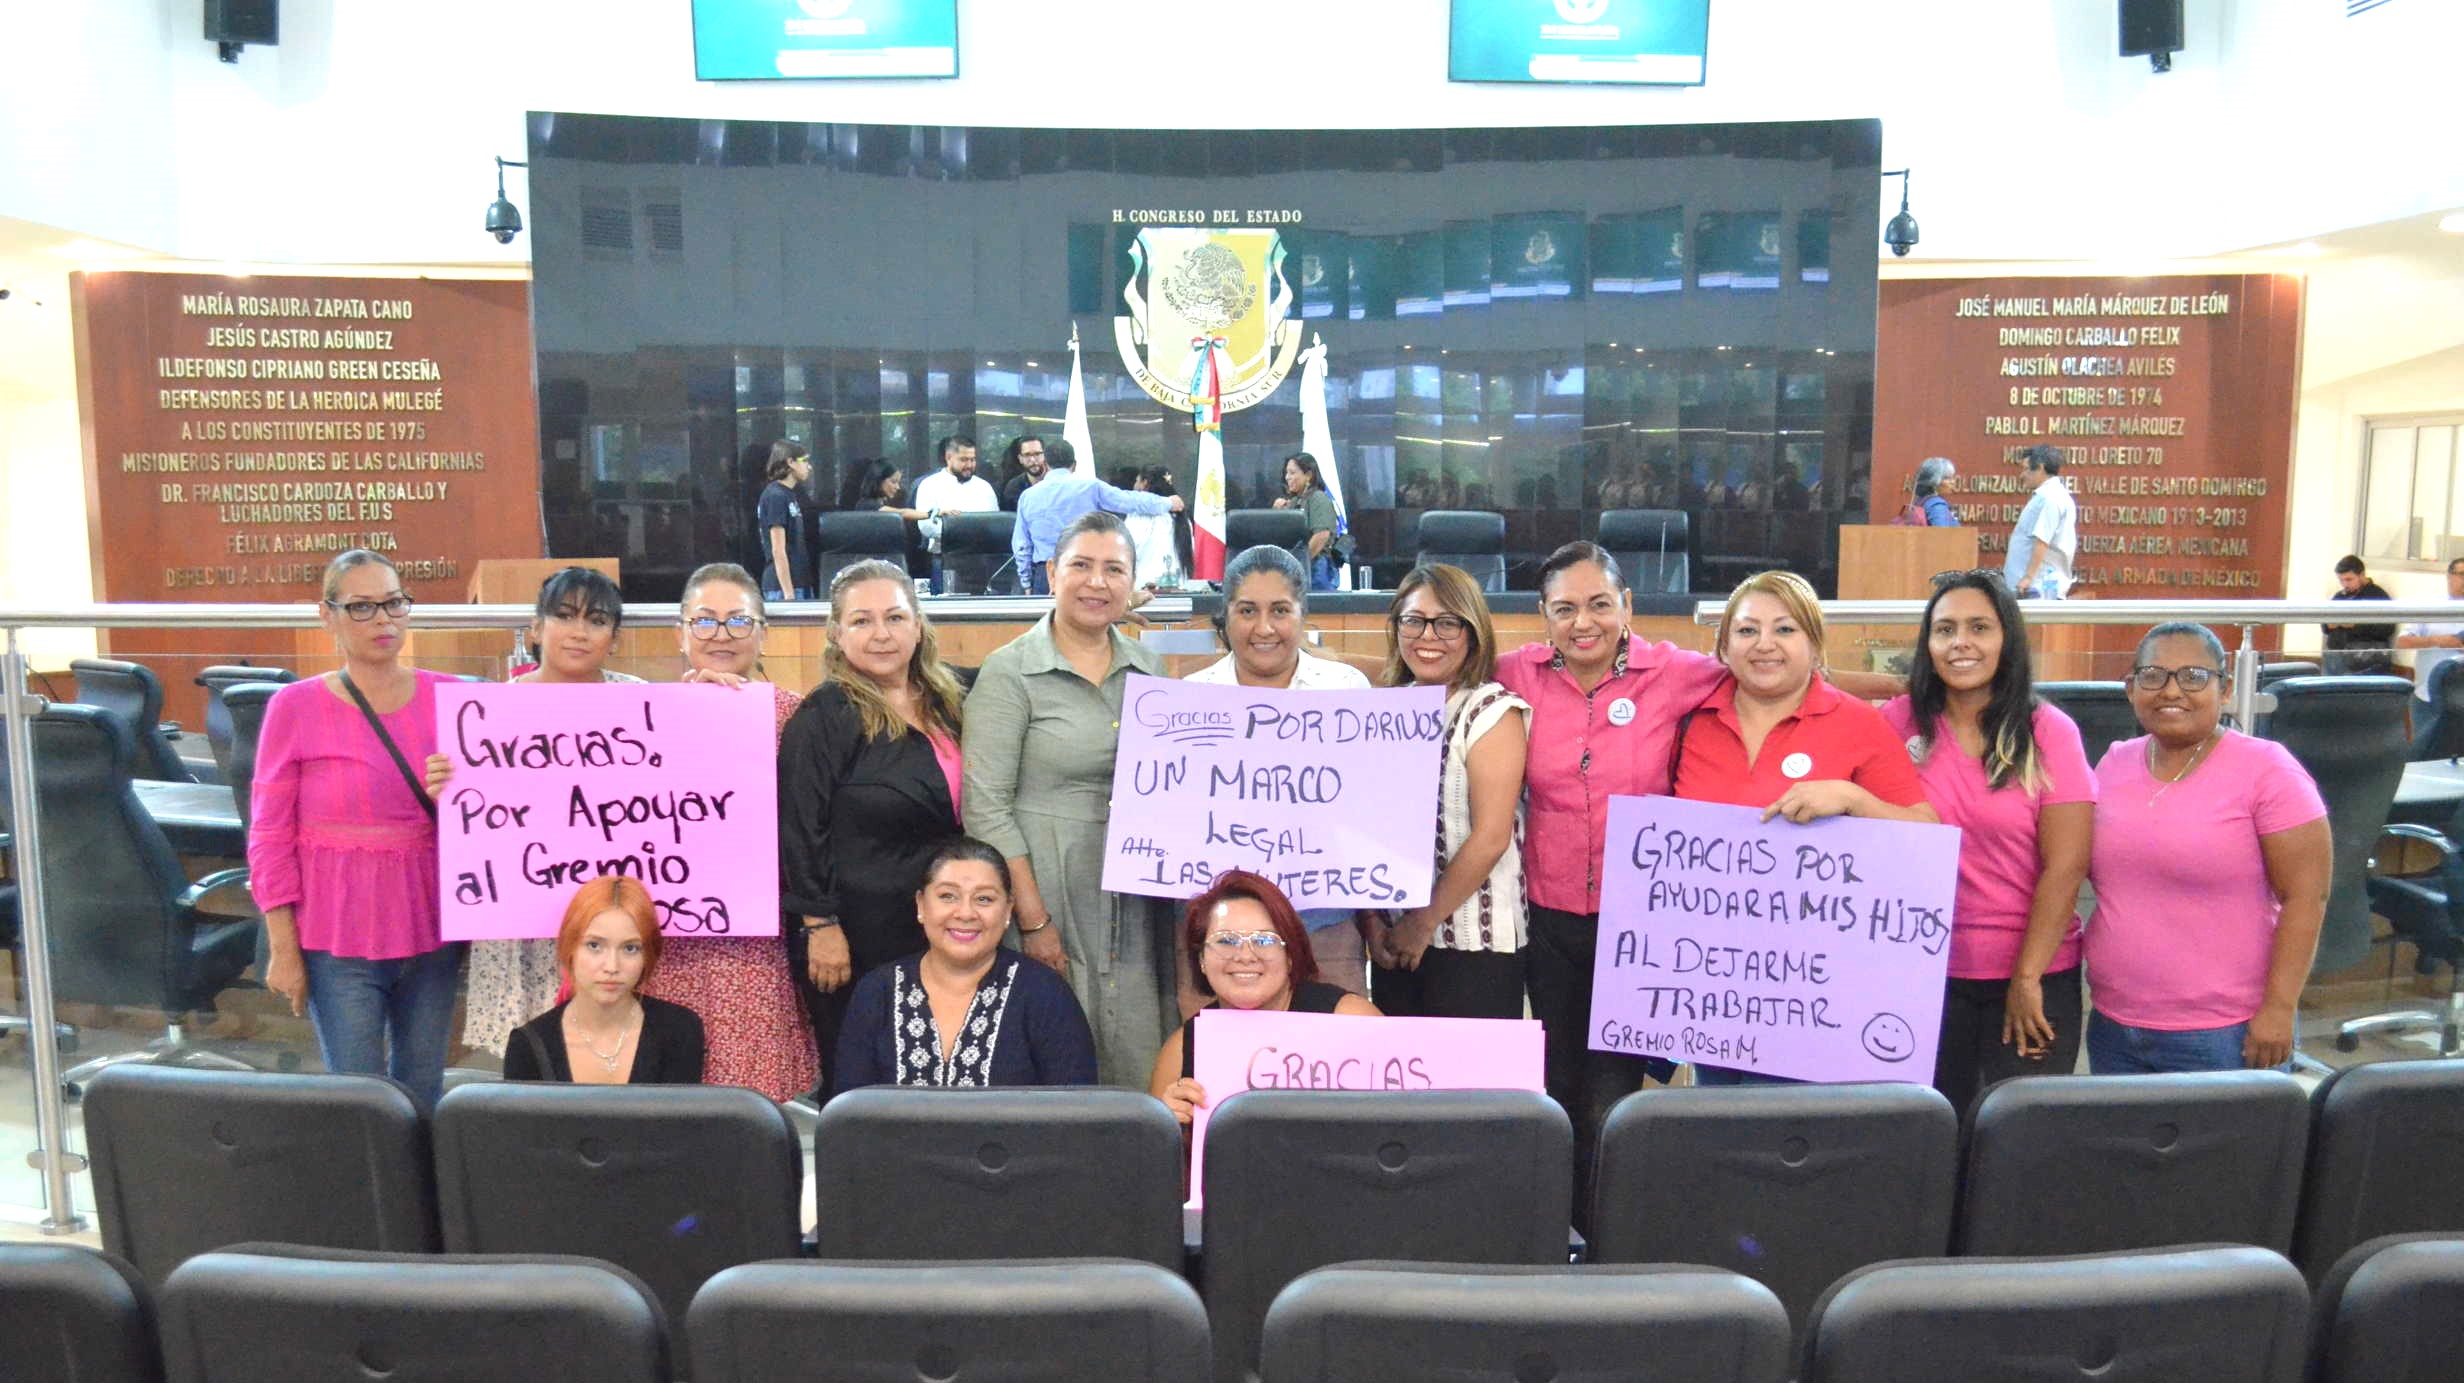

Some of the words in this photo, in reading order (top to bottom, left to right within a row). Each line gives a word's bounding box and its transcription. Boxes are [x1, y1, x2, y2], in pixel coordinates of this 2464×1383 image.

[1129, 209, 1206, 223] CONGRESO
[1213, 209, 1239, 223] DEL
[1247, 209, 1302, 223] ESTADO
[183, 291, 234, 316] MARÍA
[238, 297, 312, 317] ROSAURA
[315, 298, 369, 319] ZAPATA
[372, 299, 413, 320] CANO
[1955, 294, 1990, 317] JOSÉ
[1993, 298, 2049, 317] MANUEL
[2052, 293, 2097, 316] MARÍA
[2100, 292, 2168, 316] MÁRQUEZ
[2170, 296, 2190, 315] DE
[2191, 291, 2229, 315] LEÓN
[207, 322, 256, 347] JESÚS
[260, 327, 320, 348] CASTRO
[324, 325, 394, 350] AGÚNDEZ
[1999, 327, 2062, 346] DOMINGO
[2065, 327, 2138, 347] CARBALLO
[159, 357, 248, 379] ILDEFONSO
[252, 359, 324, 380] CIPRIANO
[329, 360, 378, 381] GREEN
[382, 358, 441, 381] CESEÑA
[2000, 353, 2058, 376] AGUSTÍN
[2061, 356, 2124, 376] OLACHEA
[1135, 368, 1150, 386] DE
[1150, 383, 1175, 402] BAJA
[1260, 370, 1283, 393] SUR
[2009, 387, 2019, 405] 8
[2022, 387, 2040, 405] DE
[2042, 387, 2105, 406] OCTUBRE
[2107, 387, 2126, 406] DE
[160, 389, 262, 410] DEFENSORES
[266, 390, 286, 410] DE
[290, 391, 310, 410] LA
[313, 391, 379, 411] HEROICA
[383, 387, 443, 411] MULEGÉ
[181, 421, 192, 440] A
[197, 421, 226, 440] LOS
[231, 421, 362, 440] CONSTITUYENTES
[366, 421, 385, 440] DE
[390, 421, 425, 440] 1975
[1985, 416, 2029, 435] PABLO
[2048, 412, 2116, 436] MARTÍNEZ
[2119, 414, 2185, 436] MÁRQUEZ
[122, 452, 221, 473] MISIONEROS
[225, 452, 326, 472] FUNDADORES
[331, 452, 350, 472] DE
[354, 452, 383, 471] LAS
[387, 451, 485, 471] CALIFORNIAS
[2091, 447, 2142, 465] LORETO
[2146, 447, 2163, 465] 70
[161, 483, 188, 503] DR.
[192, 483, 279, 503] FRANCISCO
[283, 482, 353, 502] CARDOZA
[356, 481, 434, 501] CARBALLO
[437, 481, 448, 500] Y
[2084, 476, 2128, 495] VALLE
[2130, 476, 2149, 495] DE
[2152, 476, 2198, 495] SANTO
[2201, 477, 2267, 496] DOMINGO
[220, 503, 323, 523] LUCHADORES
[327, 503, 356, 522] DEL
[2096, 506, 2167, 525] MEXICANO
[2171, 507, 2248, 526] 1913-2013
[228, 530, 269, 554] FÉLIX
[361, 531, 398, 551] COTA
[2088, 567, 2108, 584] LA
[2203, 566, 2261, 587] MÉXICO
[1135, 689, 1233, 737] Gracias
[1245, 703, 1324, 743] POR
[1335, 707, 1445, 743] DARNOS
[456, 699, 662, 768] Gracias!
[1134, 755, 1186, 796] UN
[1209, 759, 1342, 804] MARCO
[451, 788, 531, 834] Por
[568, 785, 735, 844] Apoyar
[1205, 810, 1324, 863] LEGAL
[1631, 822, 1777, 879] GRACIAS
[1794, 844, 1864, 884] POR
[455, 859, 498, 905] al
[522, 840, 690, 889] Gremio
[1138, 858, 1213, 886] LAS
[654, 896, 730, 934] osa
[1799, 894, 1858, 932] MIS
[1613, 930, 1660, 969] AL
[1672, 936, 1831, 985] DEJARME
[1600, 1019, 1675, 1053] GREMIO
[1246, 1046, 1433, 1090] GRACIAS
